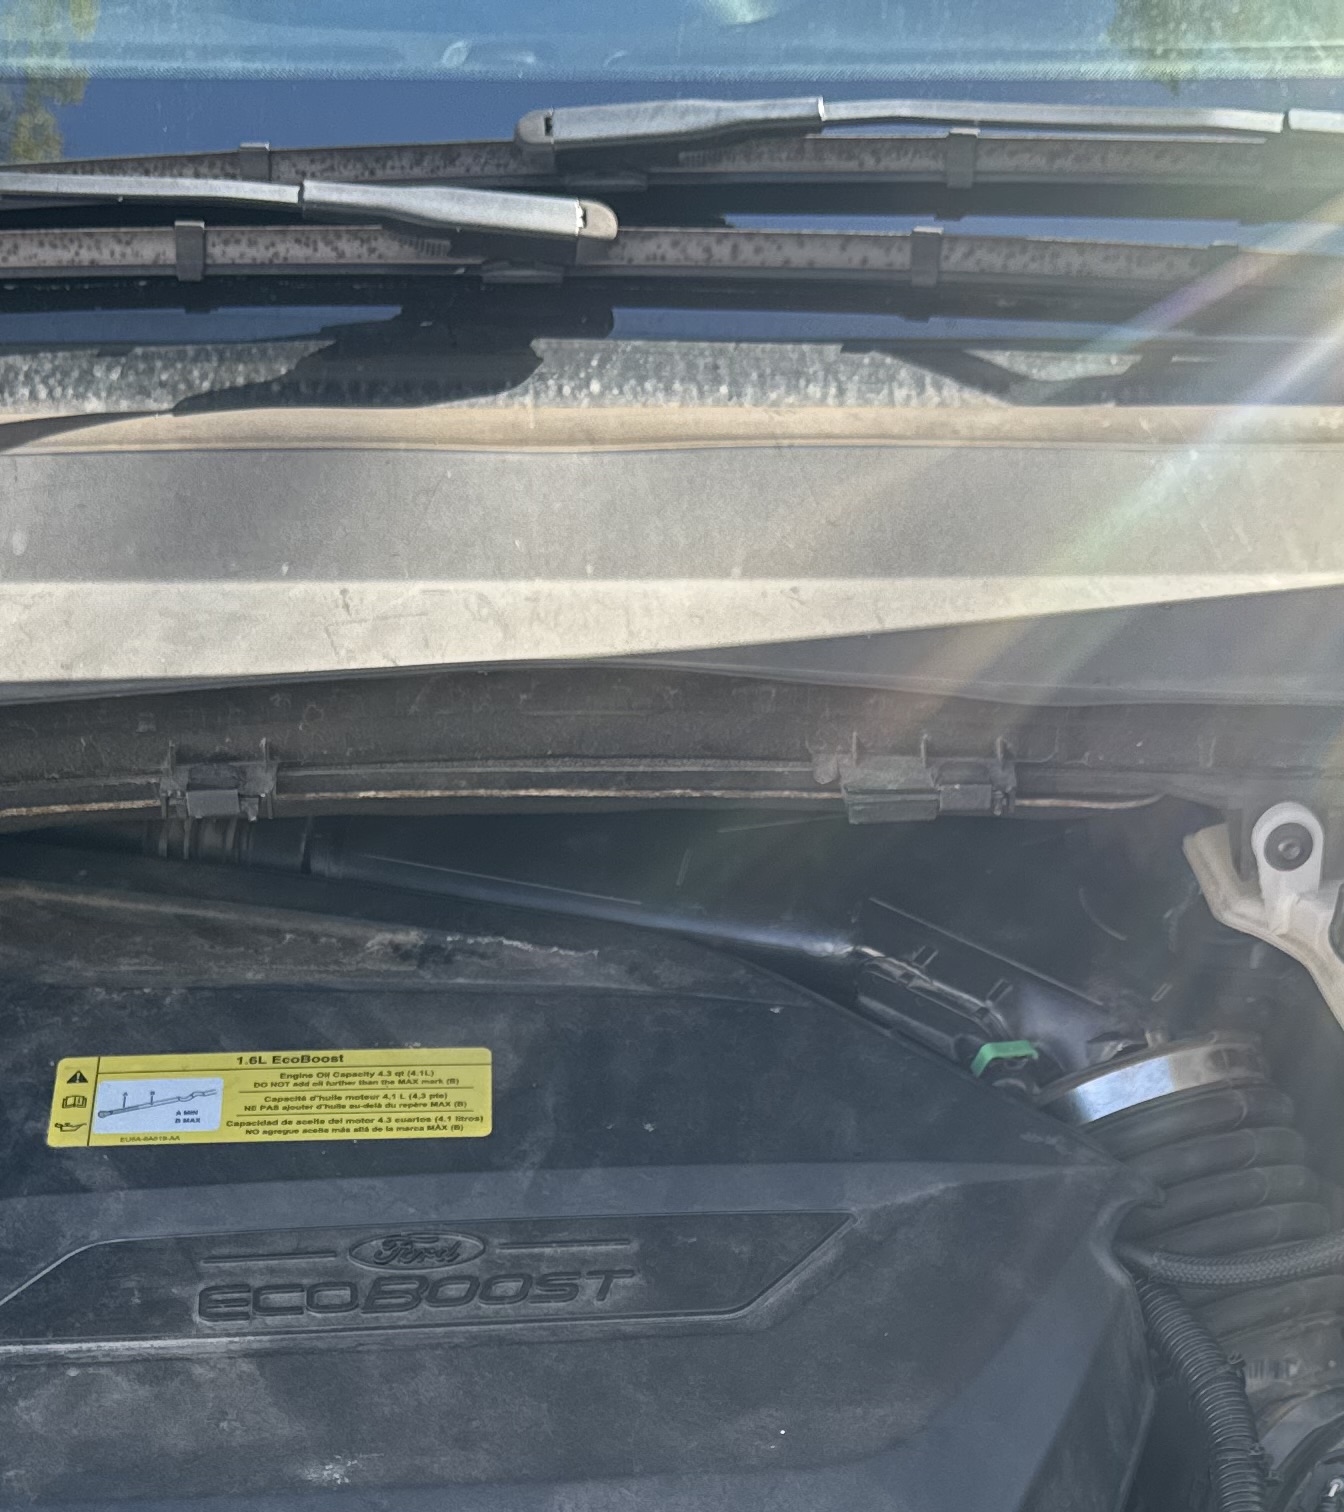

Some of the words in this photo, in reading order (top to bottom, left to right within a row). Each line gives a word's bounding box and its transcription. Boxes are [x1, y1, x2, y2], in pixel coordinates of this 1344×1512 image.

[236, 1056, 267, 1065] 1.6L
[272, 1054, 344, 1065] EcoBoost
[279, 1072, 314, 1080] Engine
[333, 1070, 375, 1079] Capacity
[264, 1095, 307, 1103] Capacité
[282, 1104, 313, 1112] ajouter
[226, 1119, 279, 1128] Capacidad
[346, 1116, 375, 1124] motor
[262, 1128, 300, 1136] agregue
[371, 1234, 464, 1266] Ford
[197, 1268, 637, 1322] ECOBOOST
